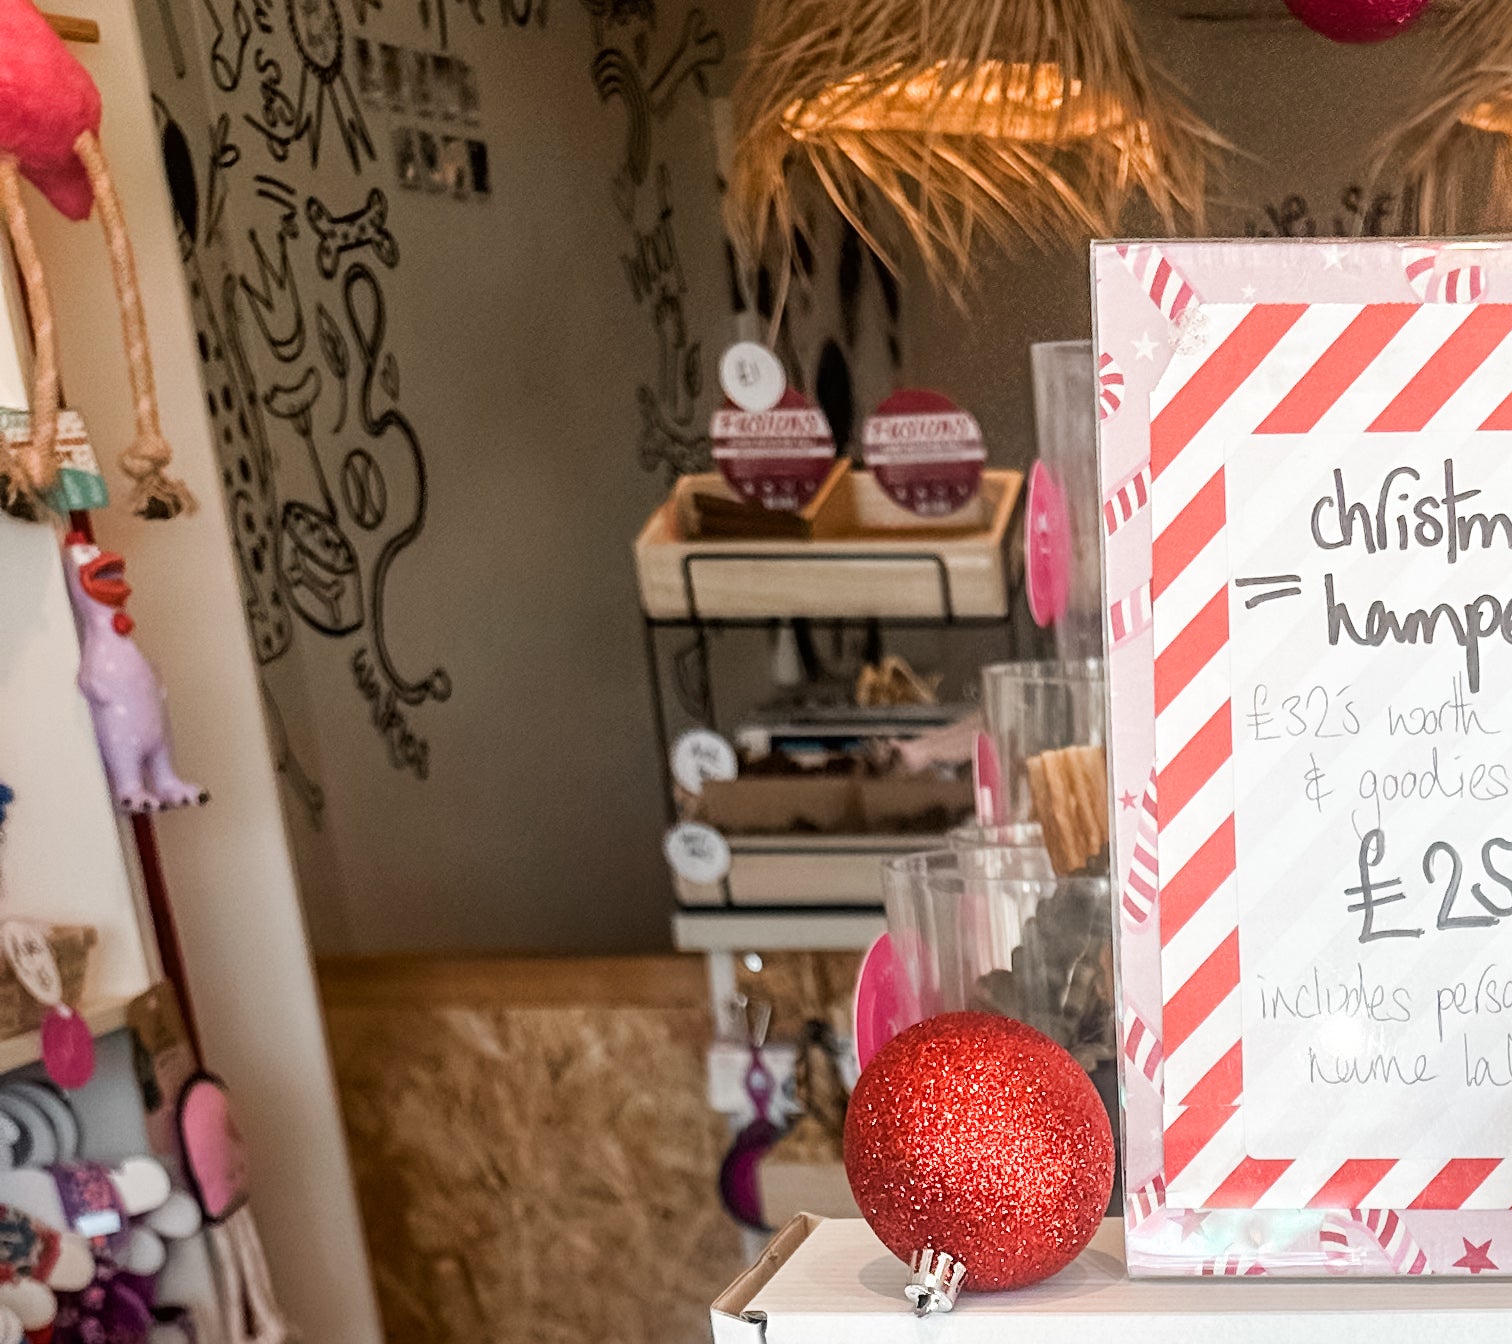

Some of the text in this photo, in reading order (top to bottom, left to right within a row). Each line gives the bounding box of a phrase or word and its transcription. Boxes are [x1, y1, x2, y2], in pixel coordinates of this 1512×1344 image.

[1388, 670, 1502, 737] worth
[1304, 753, 1333, 812] &
[1352, 747, 1510, 851] goodies
[1257, 963, 1411, 1022] includes
[1308, 1047, 1436, 1085] name
